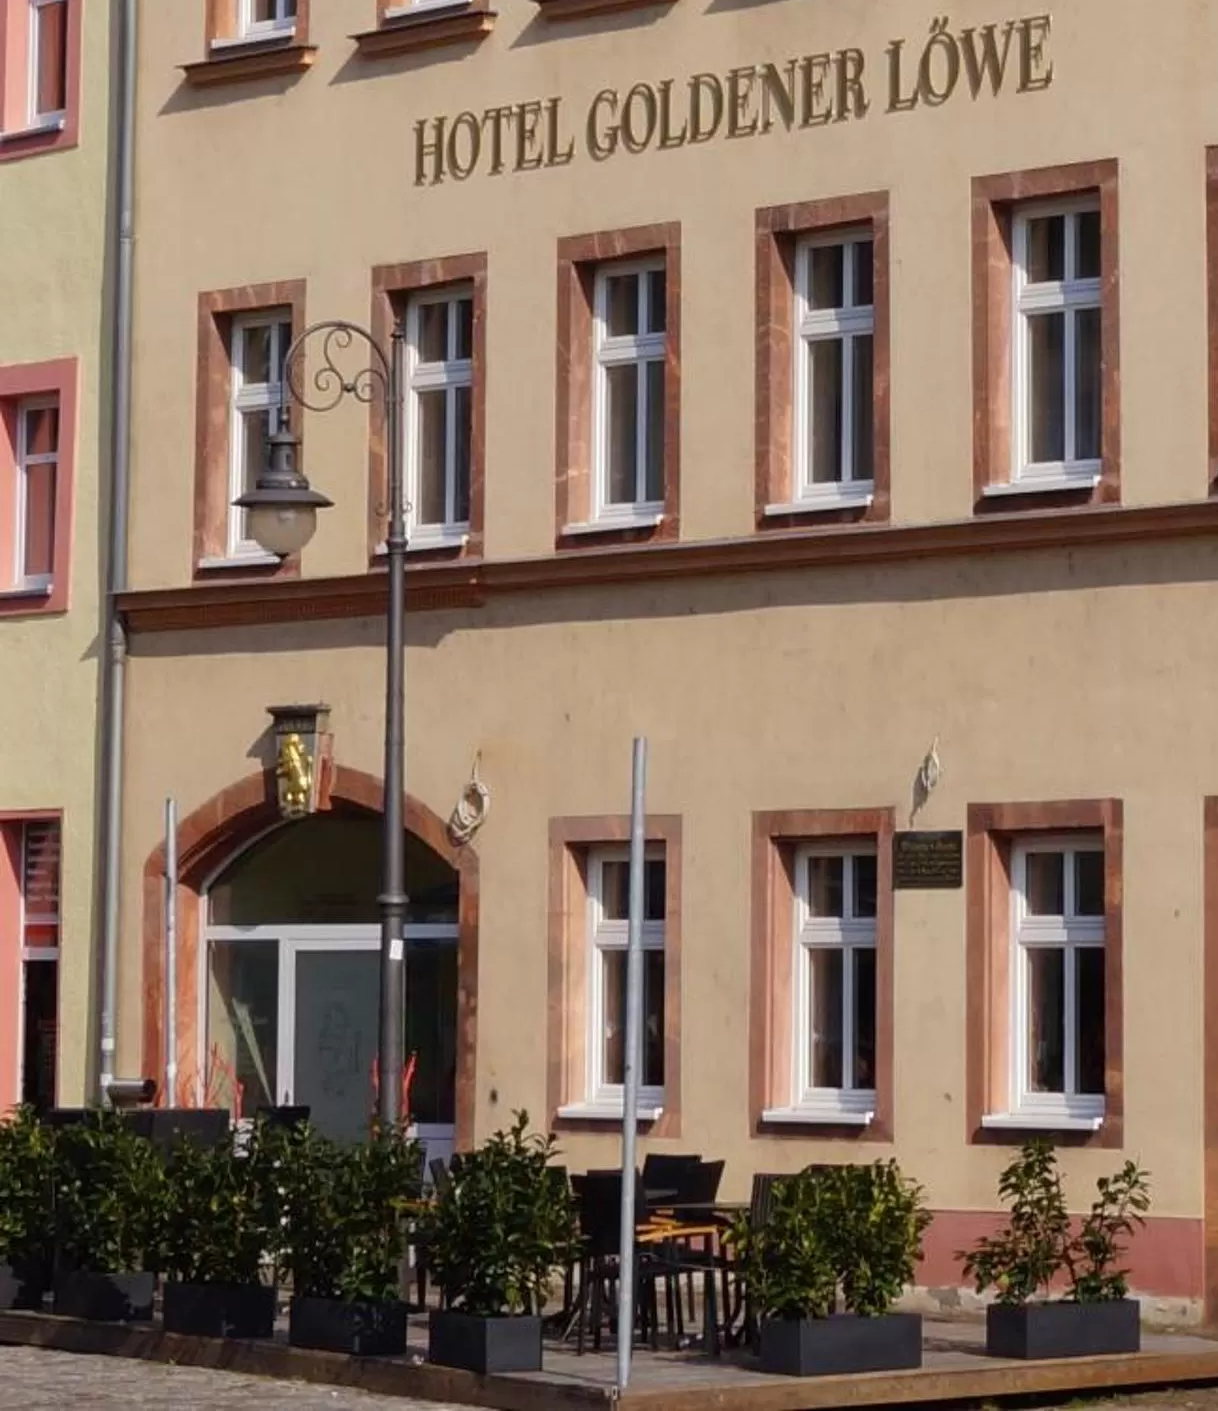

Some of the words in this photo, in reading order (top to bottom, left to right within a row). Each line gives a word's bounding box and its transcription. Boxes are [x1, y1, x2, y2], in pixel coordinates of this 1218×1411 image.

[413, 96, 575, 186] HOTEL
[586, 47, 869, 162] GOLDENER
[884, 15, 1054, 115] LÖWE
